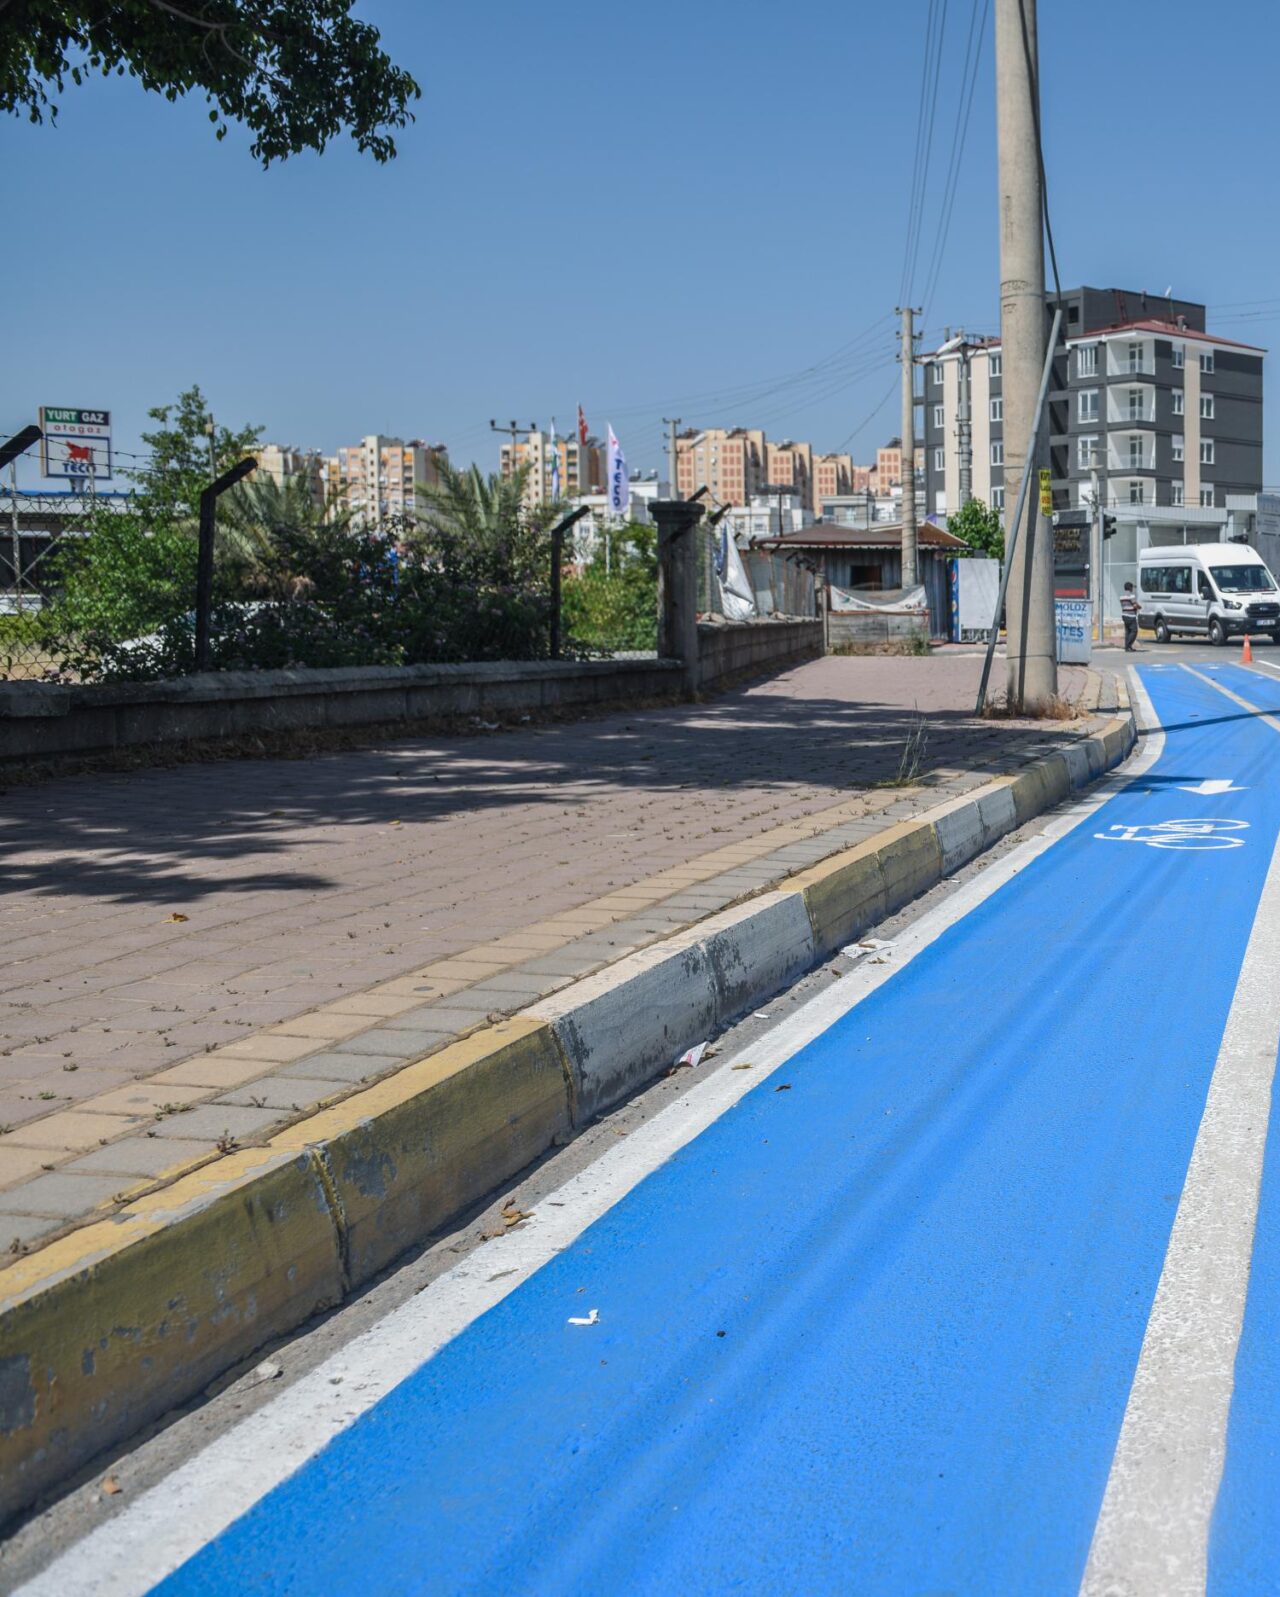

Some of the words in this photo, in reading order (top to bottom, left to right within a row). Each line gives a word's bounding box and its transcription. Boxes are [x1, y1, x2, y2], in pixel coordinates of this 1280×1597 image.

[46, 409, 77, 420] YURT
[81, 412, 105, 423] GAZ
[62, 462, 97, 474] TECO
[612, 458, 622, 507] TECO
